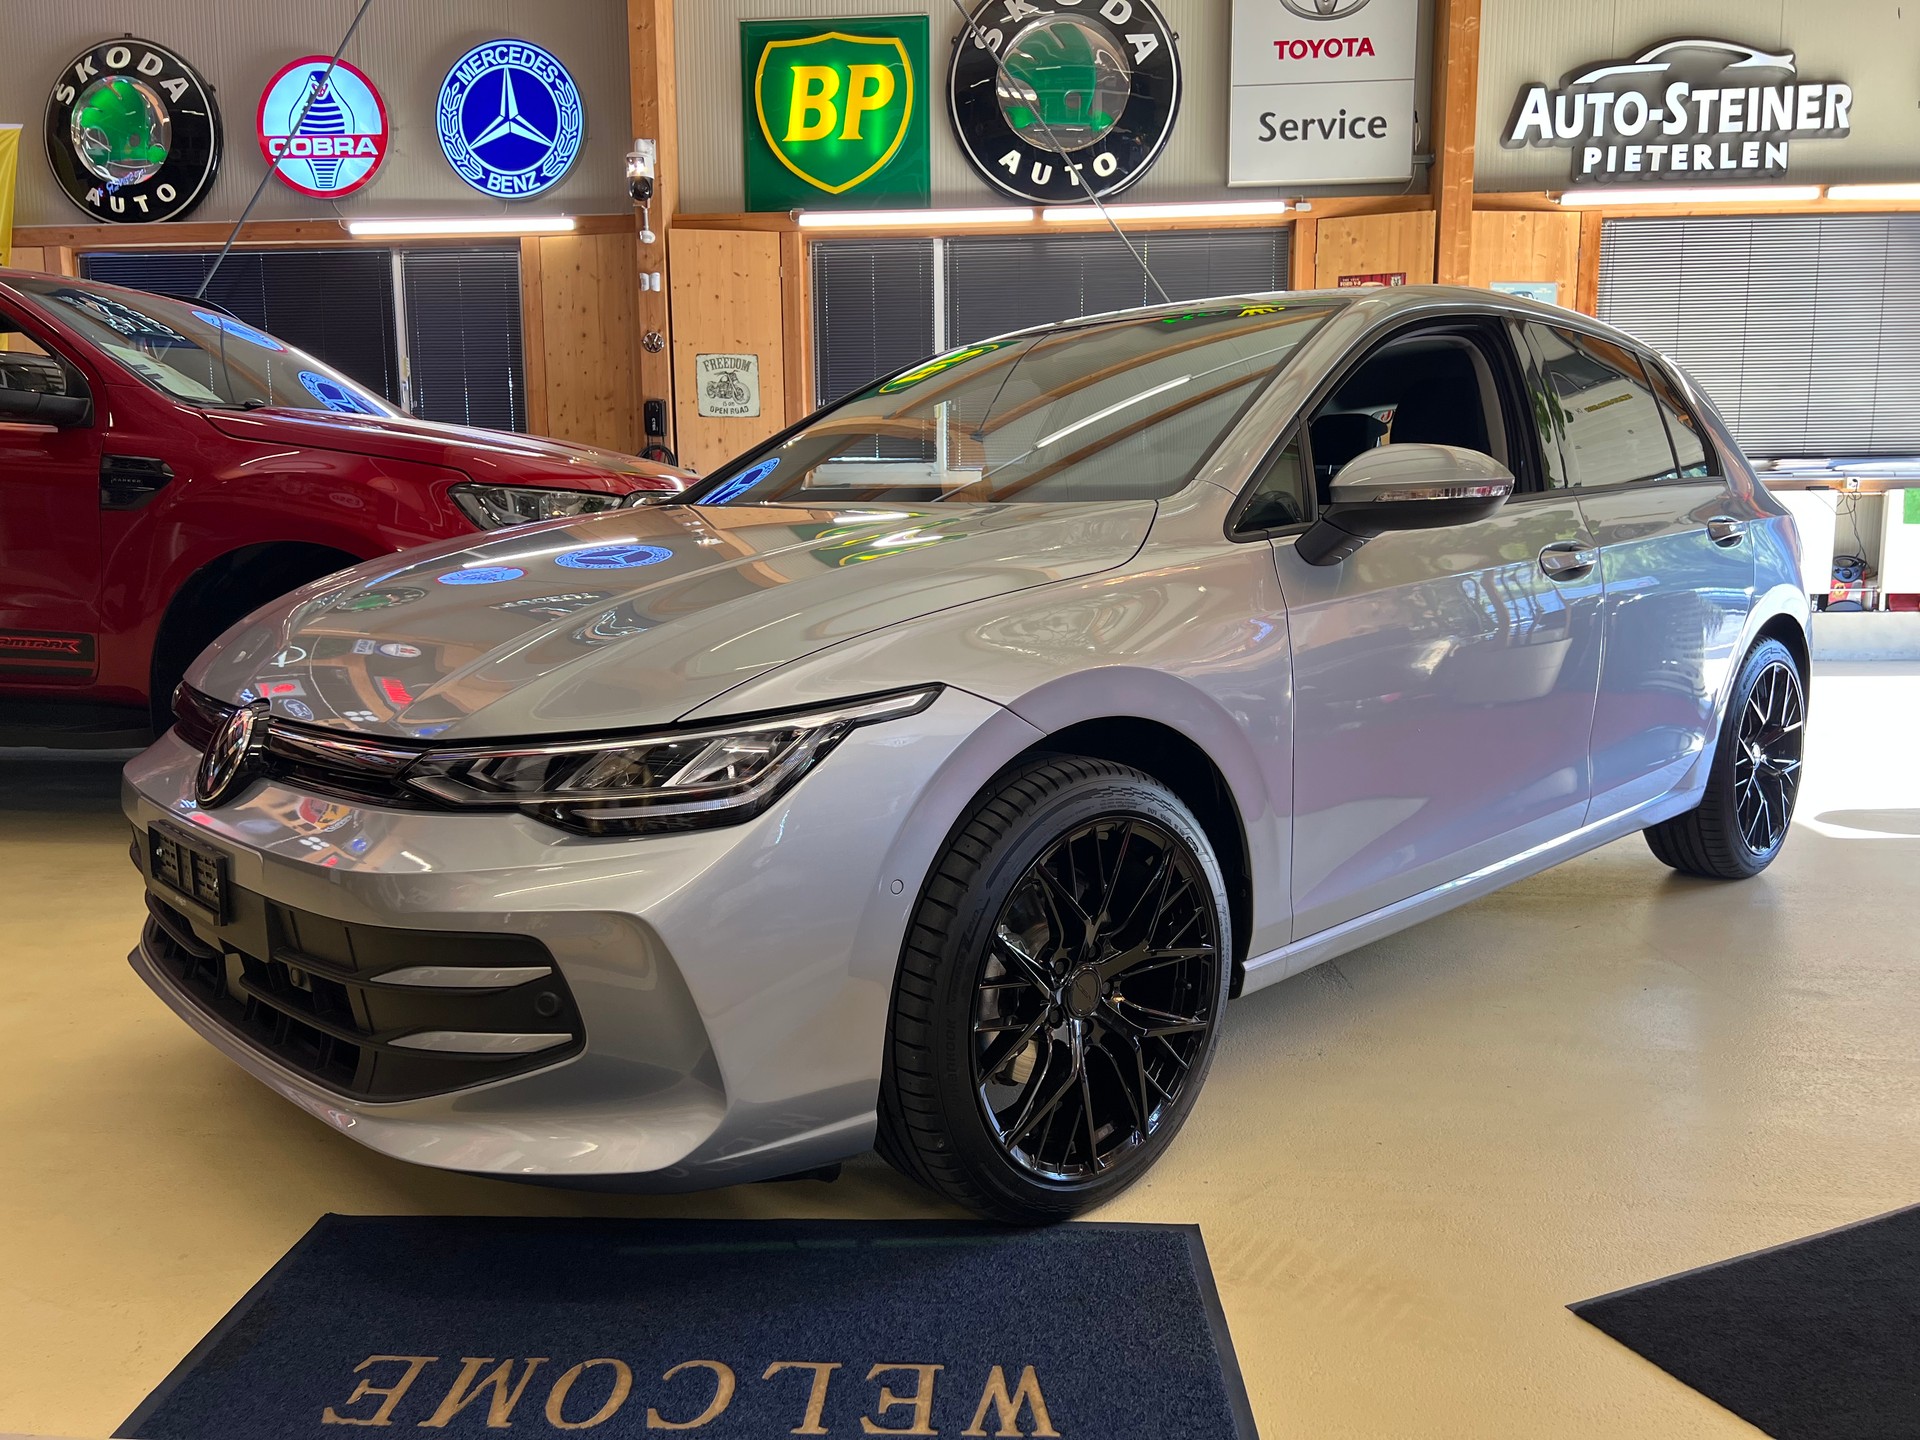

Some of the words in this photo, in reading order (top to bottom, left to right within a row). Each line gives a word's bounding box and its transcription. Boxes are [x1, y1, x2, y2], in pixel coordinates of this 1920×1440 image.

[1273, 37, 1375, 60] TOYOTA
[455, 46, 558, 86] MERCEDES
[782, 63, 895, 142] BP
[1511, 82, 1853, 140] AUTO-STEINER
[1258, 108, 1388, 143] Service
[268, 137, 379, 156] COBRA
[1582, 141, 1788, 174] PIETERLEN
[486, 174, 541, 193] BENZ
[998, 149, 1118, 186] AUTO
[85, 183, 177, 213] AUTO
[703, 356, 752, 372] FREEDOM
[710, 405, 728, 415] OPEN
[730, 405, 749, 415] ROAD
[321, 1354, 1061, 1438] WELCOME
